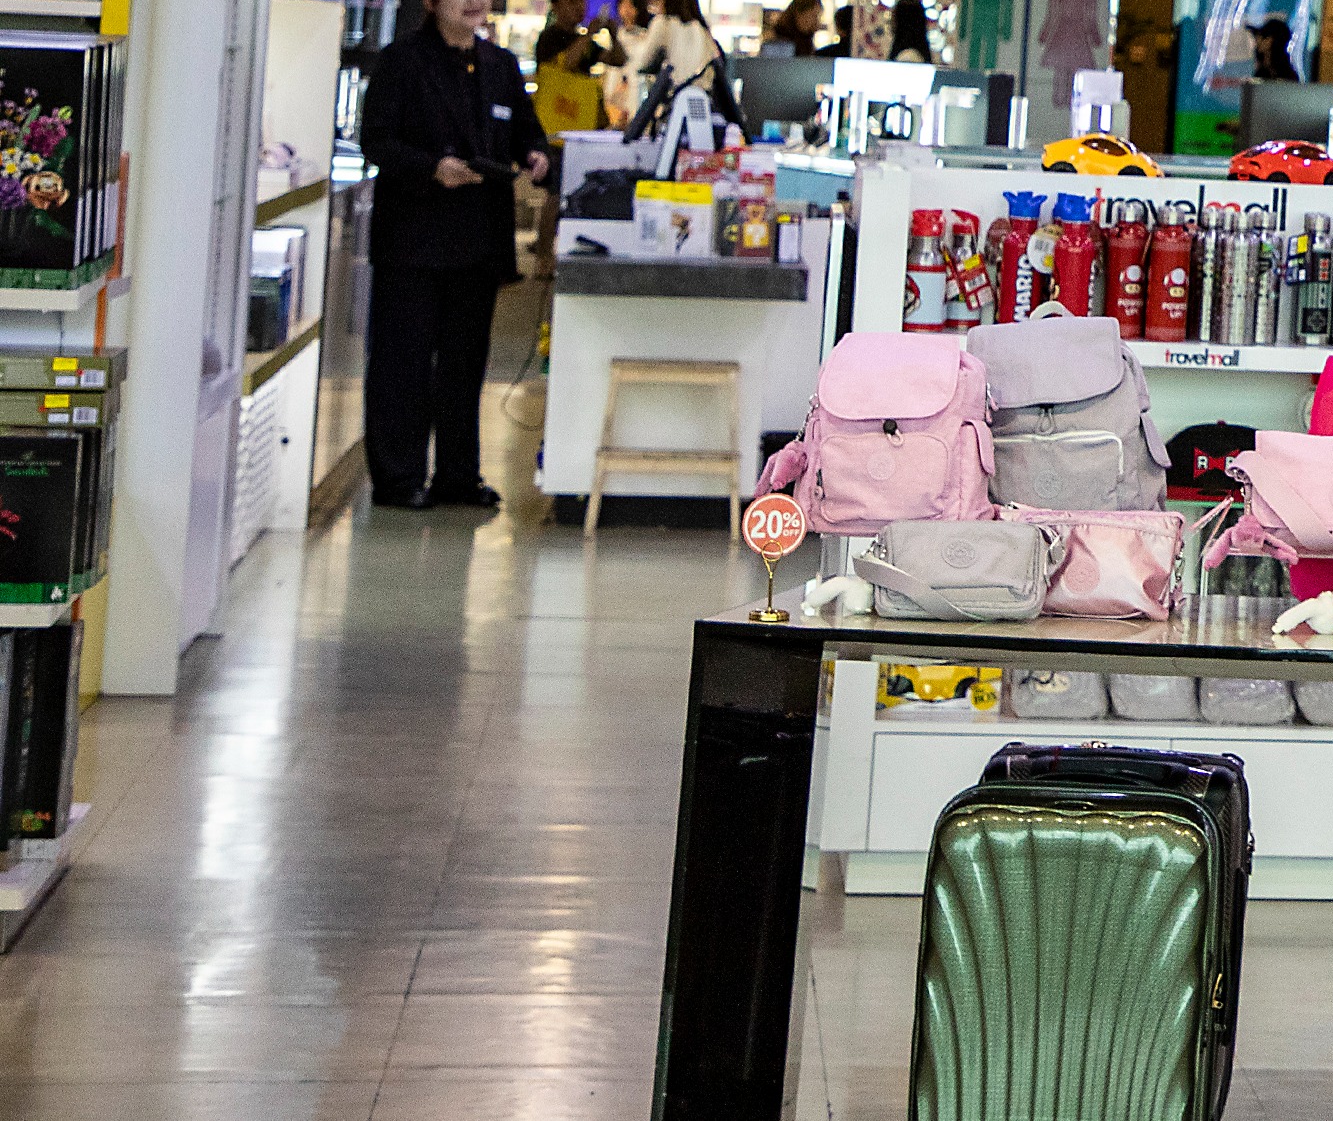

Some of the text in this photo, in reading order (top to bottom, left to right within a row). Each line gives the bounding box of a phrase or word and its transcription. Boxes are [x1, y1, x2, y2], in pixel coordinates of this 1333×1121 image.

[1013, 253, 1035, 322] MARIO
[1165, 349, 1240, 367] travelmall
[751, 509, 800, 540] 20%
[782, 530, 800, 538] OFF
